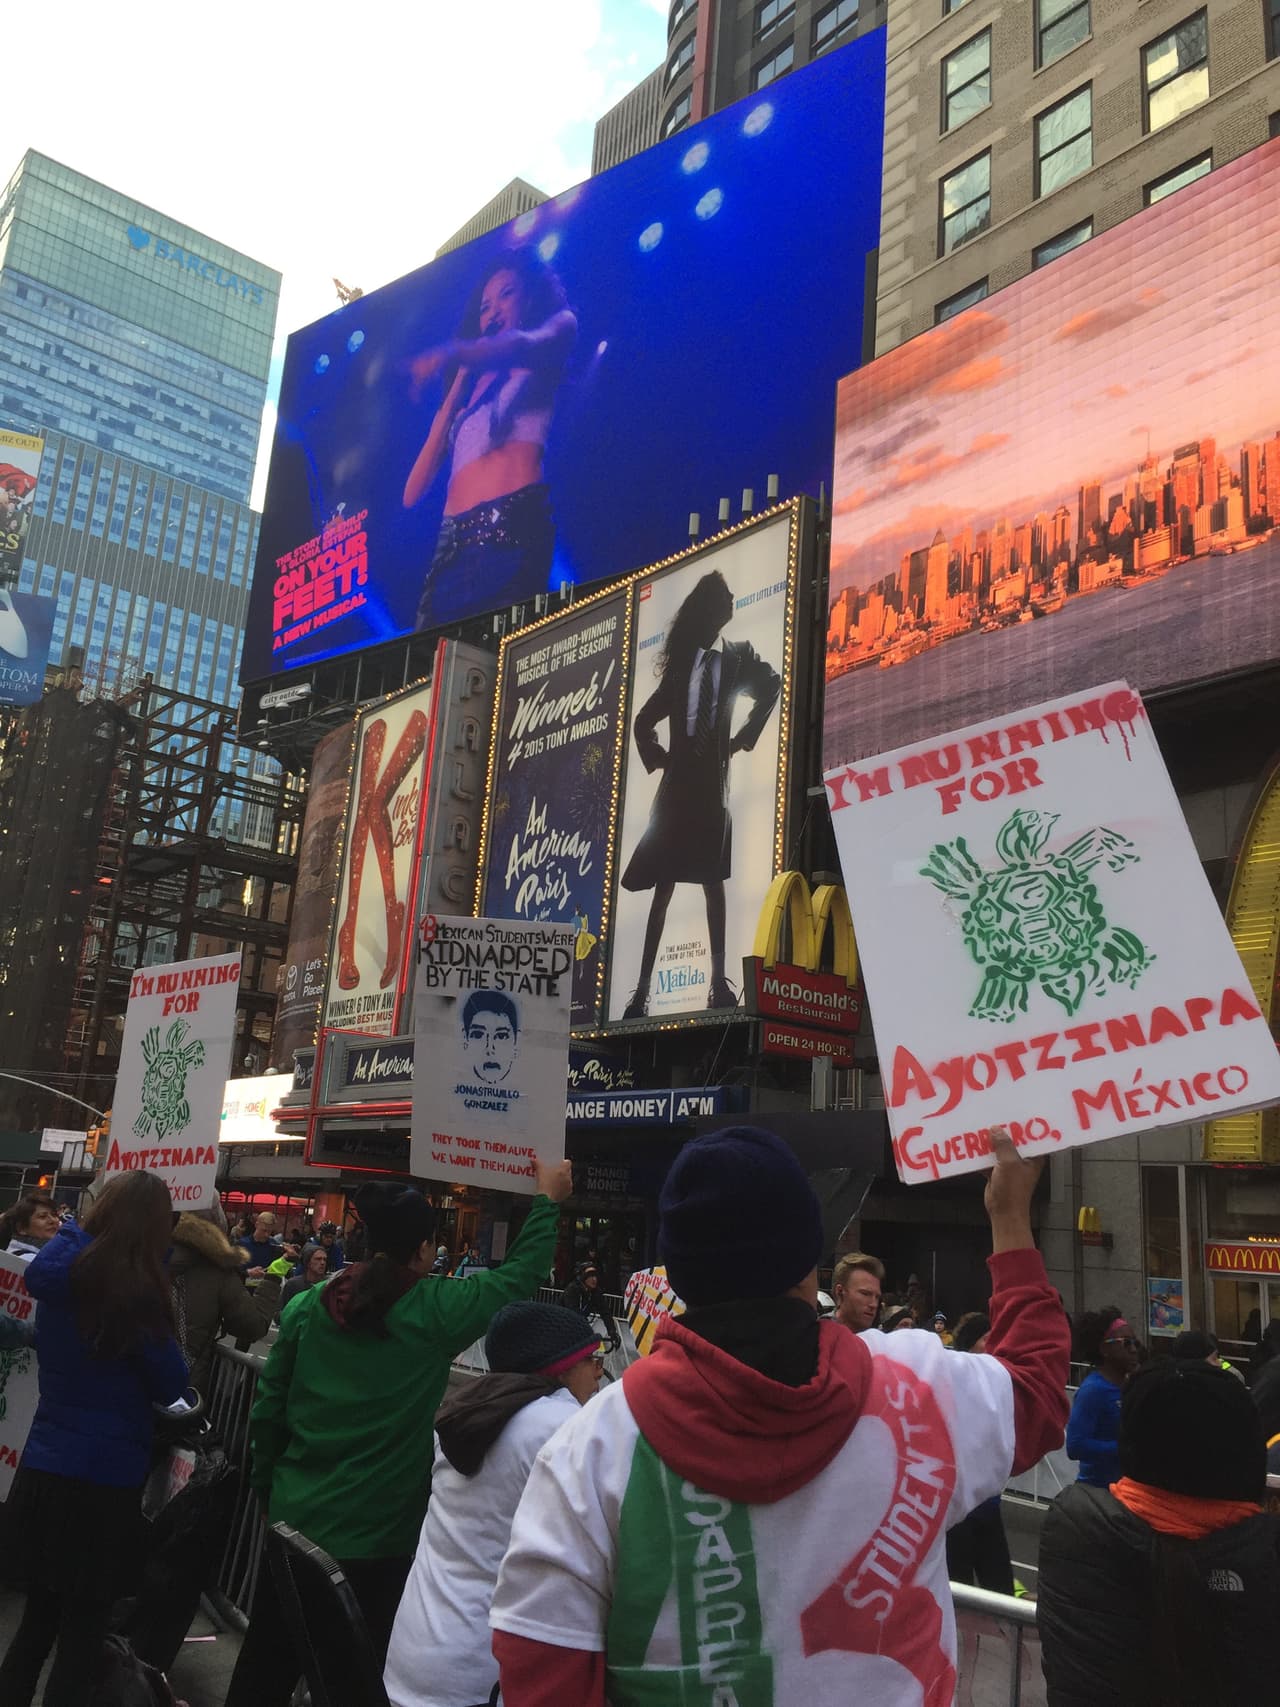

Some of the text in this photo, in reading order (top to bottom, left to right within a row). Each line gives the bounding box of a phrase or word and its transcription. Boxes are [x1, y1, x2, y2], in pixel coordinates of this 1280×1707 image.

[155, 239, 263, 304] BARCLAYS
[273, 531, 368, 598] ON YOUR
[276, 552, 292, 567] THE
[294, 535, 321, 557] STORY
[289, 546, 320, 569] GLORIA
[273, 552, 368, 632] FEET!
[273, 592, 367, 651] A NEW MUSICAL
[516, 615, 617, 673] THE MOST AWARD-WINNING
[517, 633, 613, 687] MUSICAL OF THE SEASON!
[509, 658, 616, 740] Winner!
[507, 713, 609, 771] 4 2015 TONY AWARDS
[825, 690, 1141, 811] I'M RUNNING
[441, 667, 487, 903] PALAC
[936, 757, 1043, 815] FOR
[523, 796, 548, 844] An
[505, 829, 592, 891] American
[515, 868, 571, 918] Paris
[436, 922, 483, 941] MEXICAN
[418, 939, 571, 976] KIDNAPPED
[129, 962, 241, 999] I'M RUNNING
[304, 972, 314, 984] Go
[426, 965, 560, 996] BY THE STATE
[656, 965, 705, 994] Matilda
[762, 976, 858, 1013] McDonald's
[163, 991, 200, 1016] FOR
[329, 997, 356, 1018] WINNER!
[363, 994, 382, 1012] TONY
[357, 1013, 375, 1025] BEST
[778, 1000, 841, 1022] Restaurant
[768, 1032, 798, 1047] OPEN
[800, 1038, 814, 1050] 24
[890, 988, 1262, 1118] AYOTZINAPA
[583, 1060, 614, 1090] Paris
[464, 1099, 508, 1112] GONZALEZ
[609, 1099, 667, 1119] MONEY
[677, 1097, 714, 1116] ATM
[1072, 1066, 1248, 1130] MÉXICO
[106, 1139, 216, 1171] AYOTZINAPA
[432, 1133, 452, 1145] THEY
[456, 1137, 480, 1150] TOOK
[432, 1151, 446, 1163] WE
[449, 1153, 475, 1168] WANT
[480, 1159, 505, 1172] THEM
[588, 1166, 630, 1179] CHANGE
[587, 1178, 629, 1192] MONEY
[844, 1379, 945, 1621] STUDENTS
